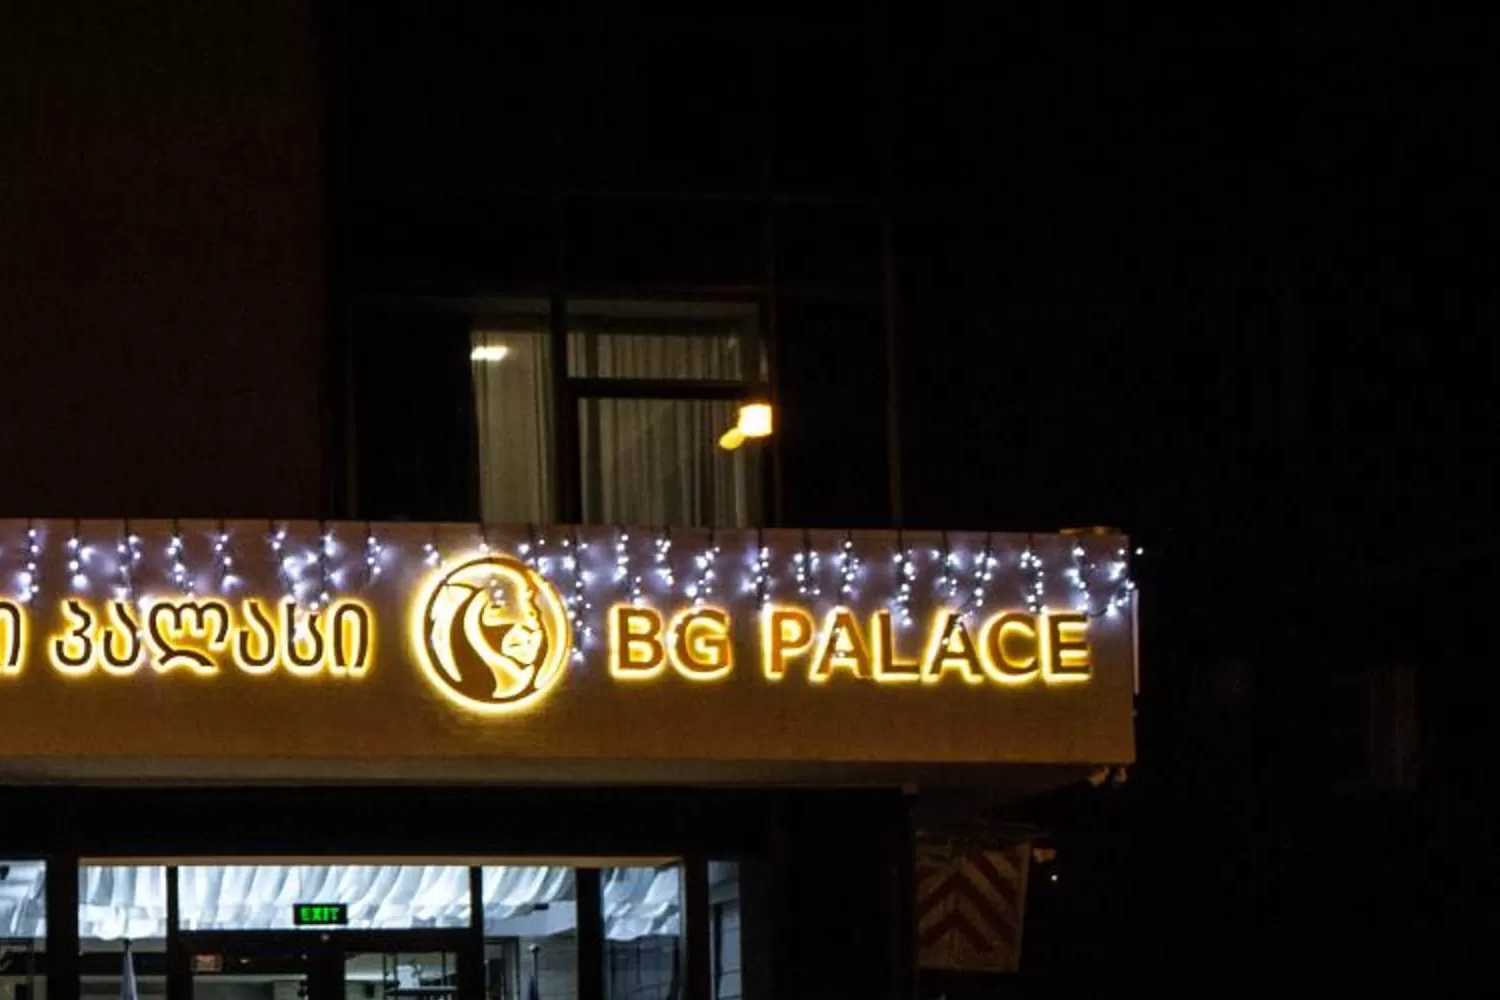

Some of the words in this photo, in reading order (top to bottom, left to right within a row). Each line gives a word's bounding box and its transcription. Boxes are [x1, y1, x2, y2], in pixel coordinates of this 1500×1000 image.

[53, 599, 371, 671] პალასი
[610, 604, 731, 680] BG
[764, 606, 1093, 682] PALACE
[301, 905, 340, 922] EXIT
